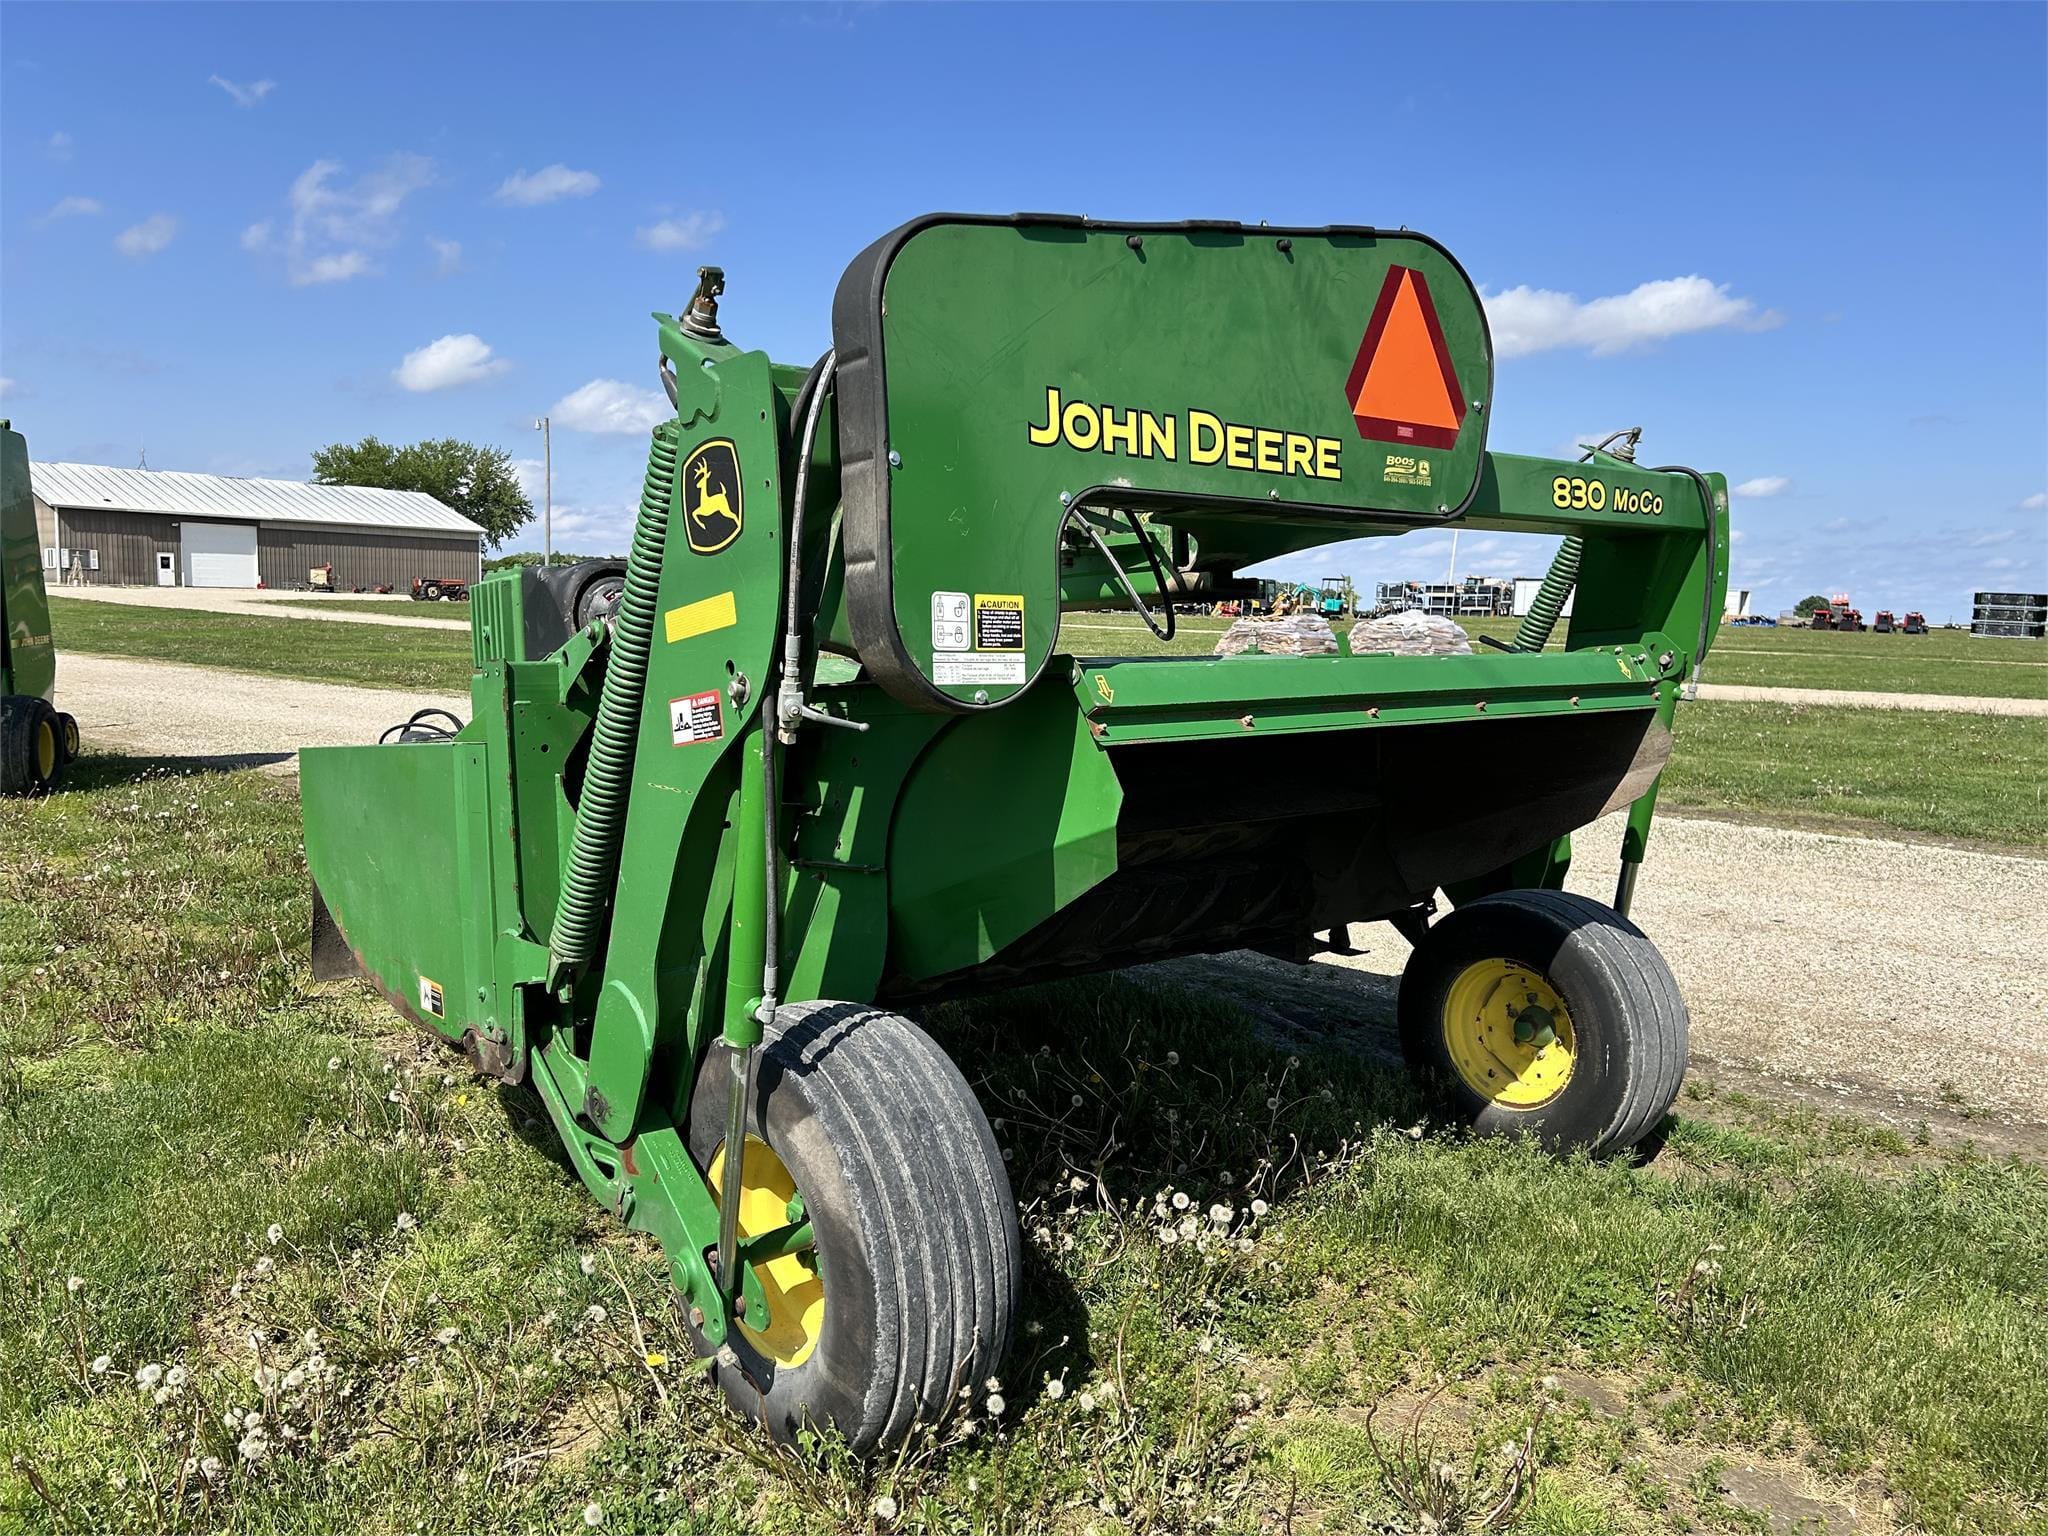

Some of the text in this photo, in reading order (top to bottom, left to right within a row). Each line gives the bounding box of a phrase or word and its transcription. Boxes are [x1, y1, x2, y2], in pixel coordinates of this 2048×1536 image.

[1028, 386, 1342, 482] JOHN DEERE
[1552, 475, 1664, 515] 830 MoCo
[986, 600, 1020, 609] CAUTION
